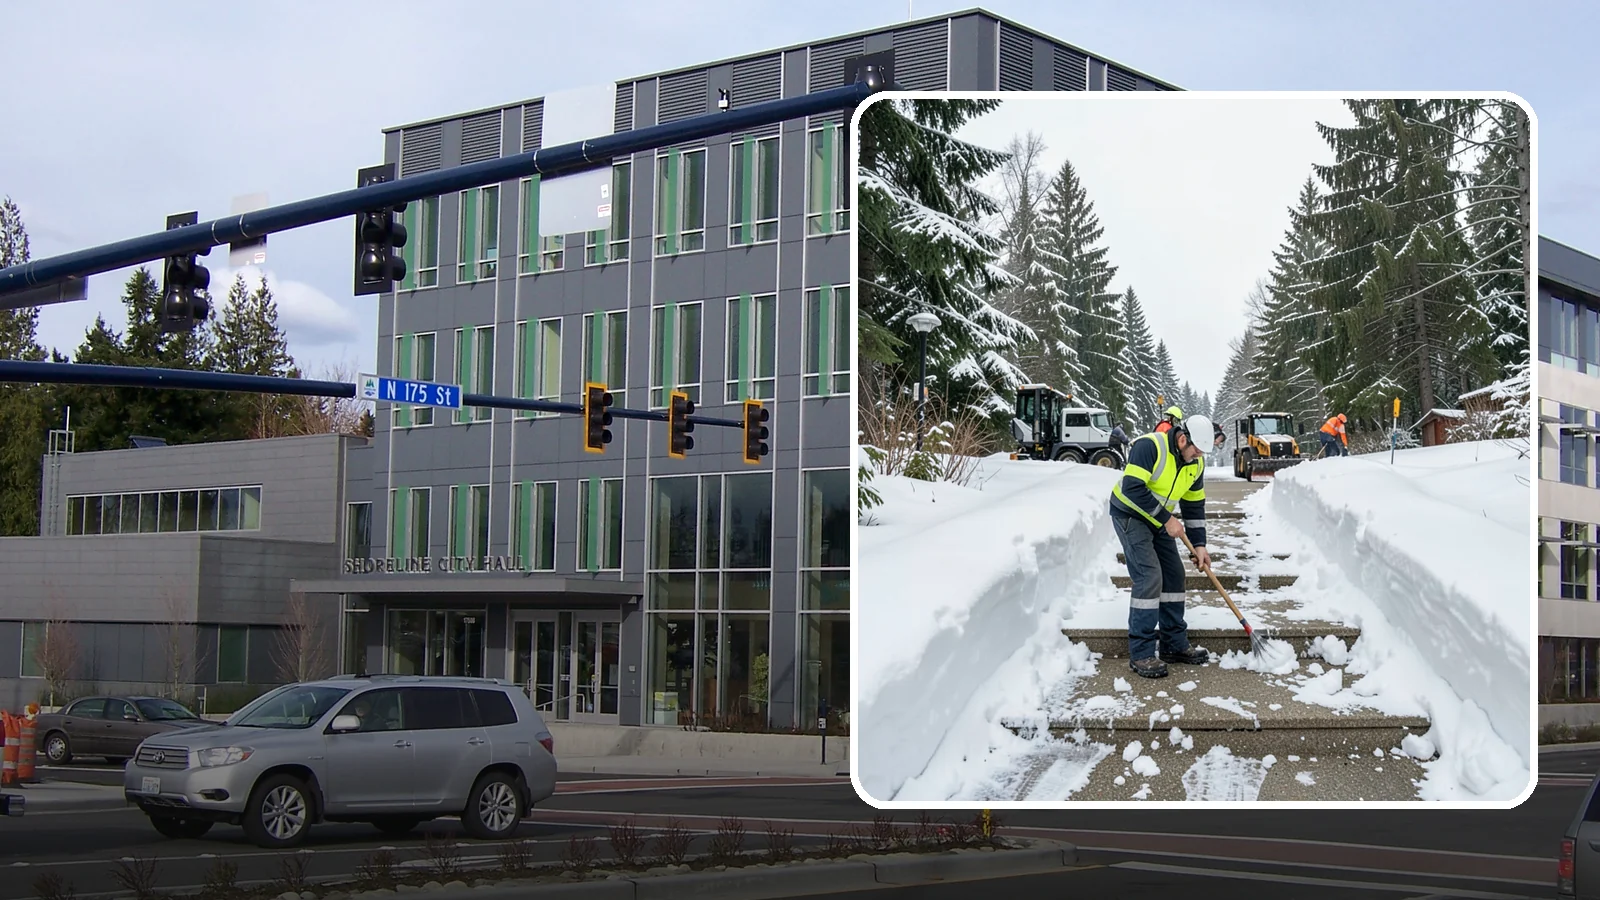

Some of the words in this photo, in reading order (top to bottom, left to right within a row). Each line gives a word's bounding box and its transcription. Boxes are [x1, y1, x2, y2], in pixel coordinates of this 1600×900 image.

[387, 380, 396, 400] N
[405, 382, 427, 403] 175
[436, 386, 451, 406] St
[344, 557, 432, 574] SHORELINE
[438, 556, 475, 573] CITY
[484, 556, 526, 573] HALL
